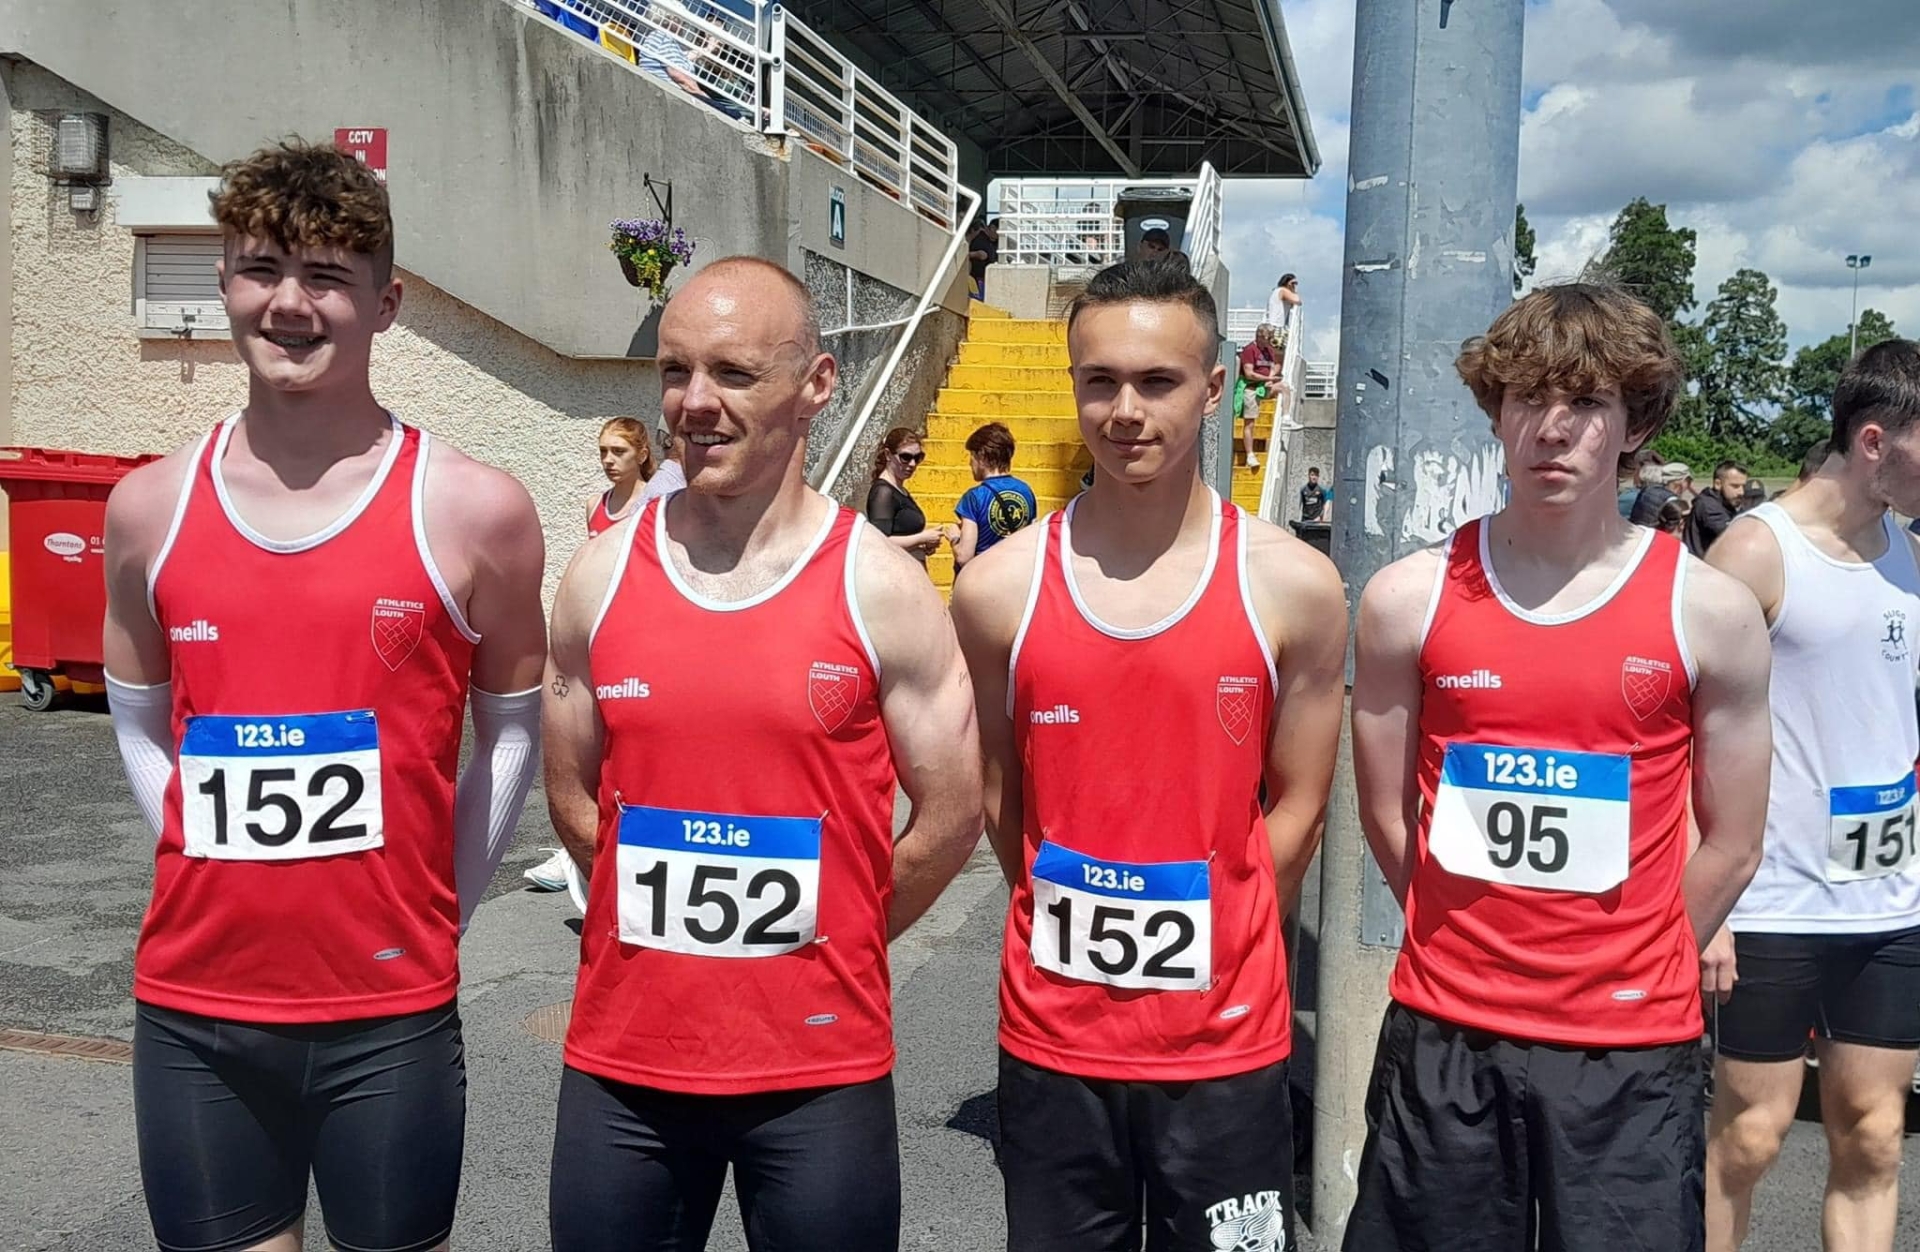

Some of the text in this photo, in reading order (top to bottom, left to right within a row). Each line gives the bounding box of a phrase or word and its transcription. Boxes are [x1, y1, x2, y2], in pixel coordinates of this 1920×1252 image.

[348, 130, 374, 144] CCTV
[355, 149, 366, 162] IN
[832, 203, 843, 239] A
[375, 609, 404, 618] LOUTH
[376, 598, 424, 609] ATHLETICS
[811, 672, 840, 682] LOUTH
[234, 723, 305, 747] 123.ie
[1483, 752, 1578, 790] 123.ie
[198, 763, 367, 847] 152
[682, 819, 750, 847] 123.ie
[1486, 801, 1569, 874] 95
[1846, 805, 1916, 871] 151
[1082, 863, 1146, 892] 123.ie
[635, 860, 801, 945] 152
[1048, 896, 1195, 979] 152
[1205, 1190, 1283, 1228] TRACK
